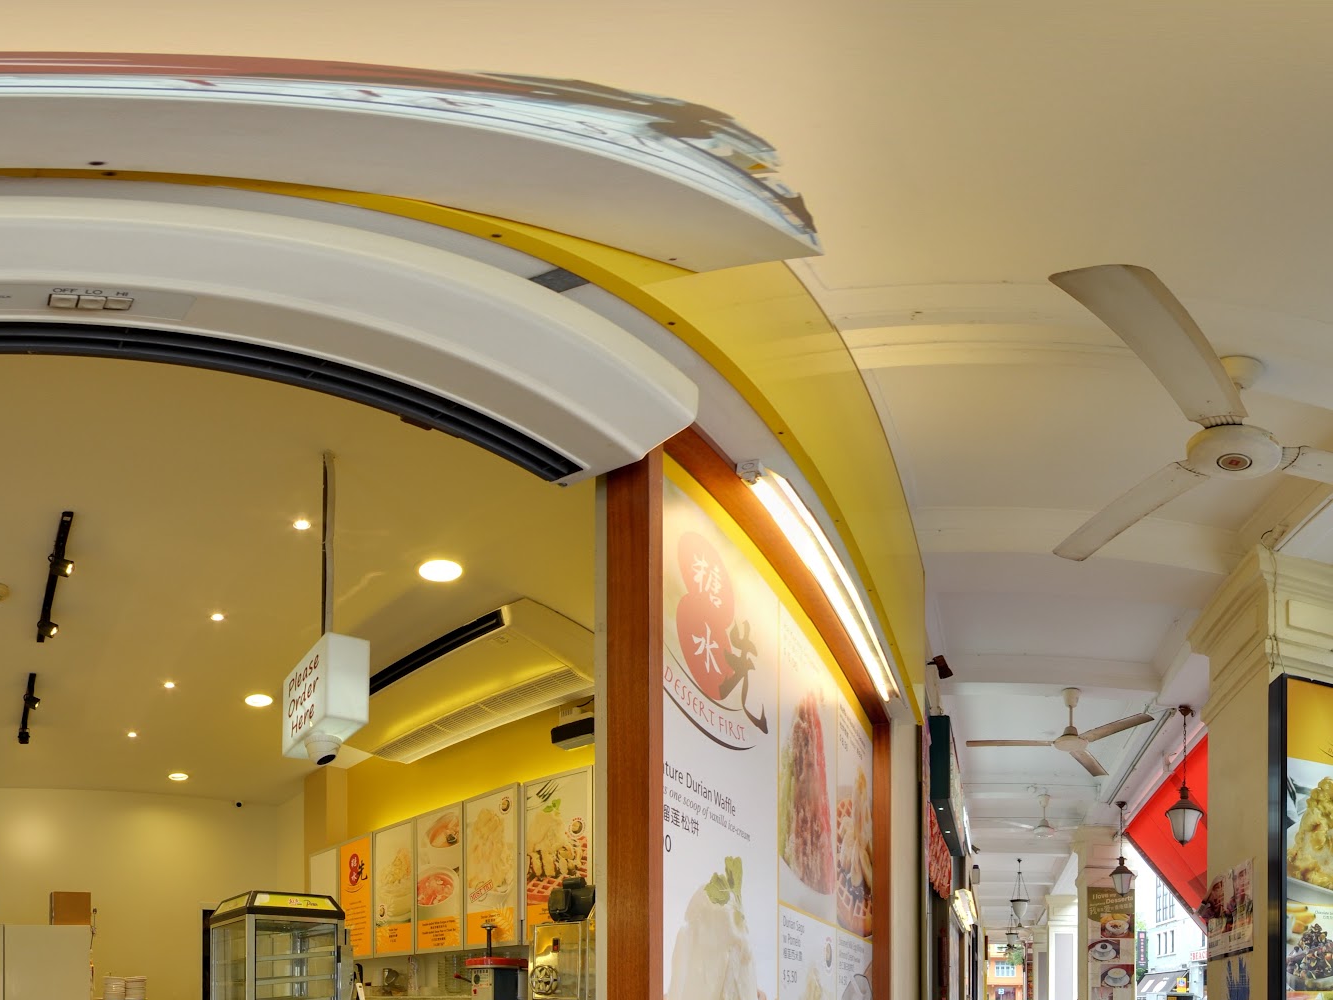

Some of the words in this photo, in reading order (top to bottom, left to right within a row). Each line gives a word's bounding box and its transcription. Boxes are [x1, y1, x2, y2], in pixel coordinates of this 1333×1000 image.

[288, 654, 319, 698] Please
[287, 676, 319, 719] Order
[664, 665, 715, 727] DESSERT
[718, 715, 746, 742] FIRST
[290, 703, 315, 738] Here
[663, 760, 684, 785] ture
[686, 772, 713, 803] Durian
[713, 789, 736, 817] Waffle
[669, 789, 682, 803] one
[683, 796, 702, 816] scoop
[702, 806, 710, 820] of
[709, 810, 728, 828] vanilla
[1105, 895, 1133, 905] Desserts
[782, 915, 796, 931] Durian
[796, 920, 805, 936] Sago
[787, 933, 801, 947] Pomelo
